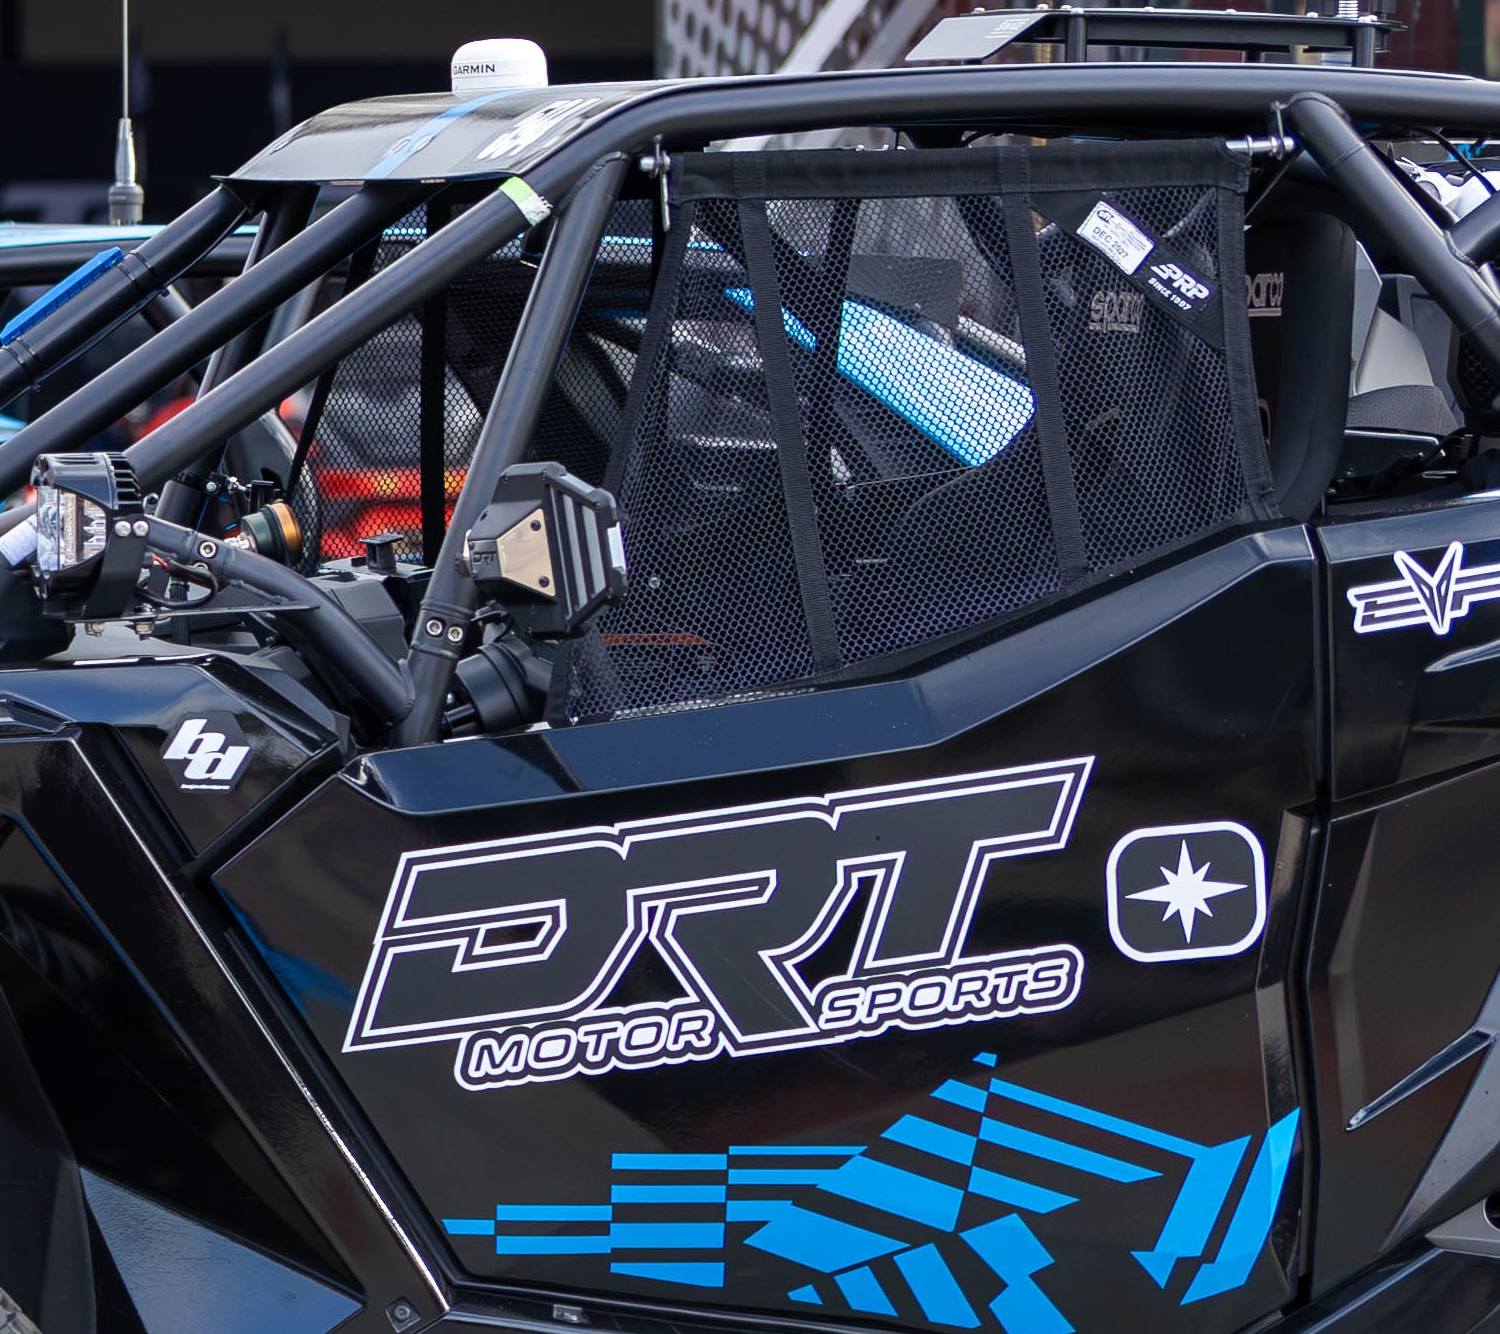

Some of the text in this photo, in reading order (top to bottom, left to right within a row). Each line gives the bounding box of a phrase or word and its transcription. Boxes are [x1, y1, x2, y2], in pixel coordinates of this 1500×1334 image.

[453, 64, 496, 76] GARMIN
[1148, 278, 1171, 300] SINCE
[1153, 263, 1210, 300] PRP
[342, 755, 1096, 1056] DRT
[468, 950, 1078, 1079] MOTOR SPORTS
